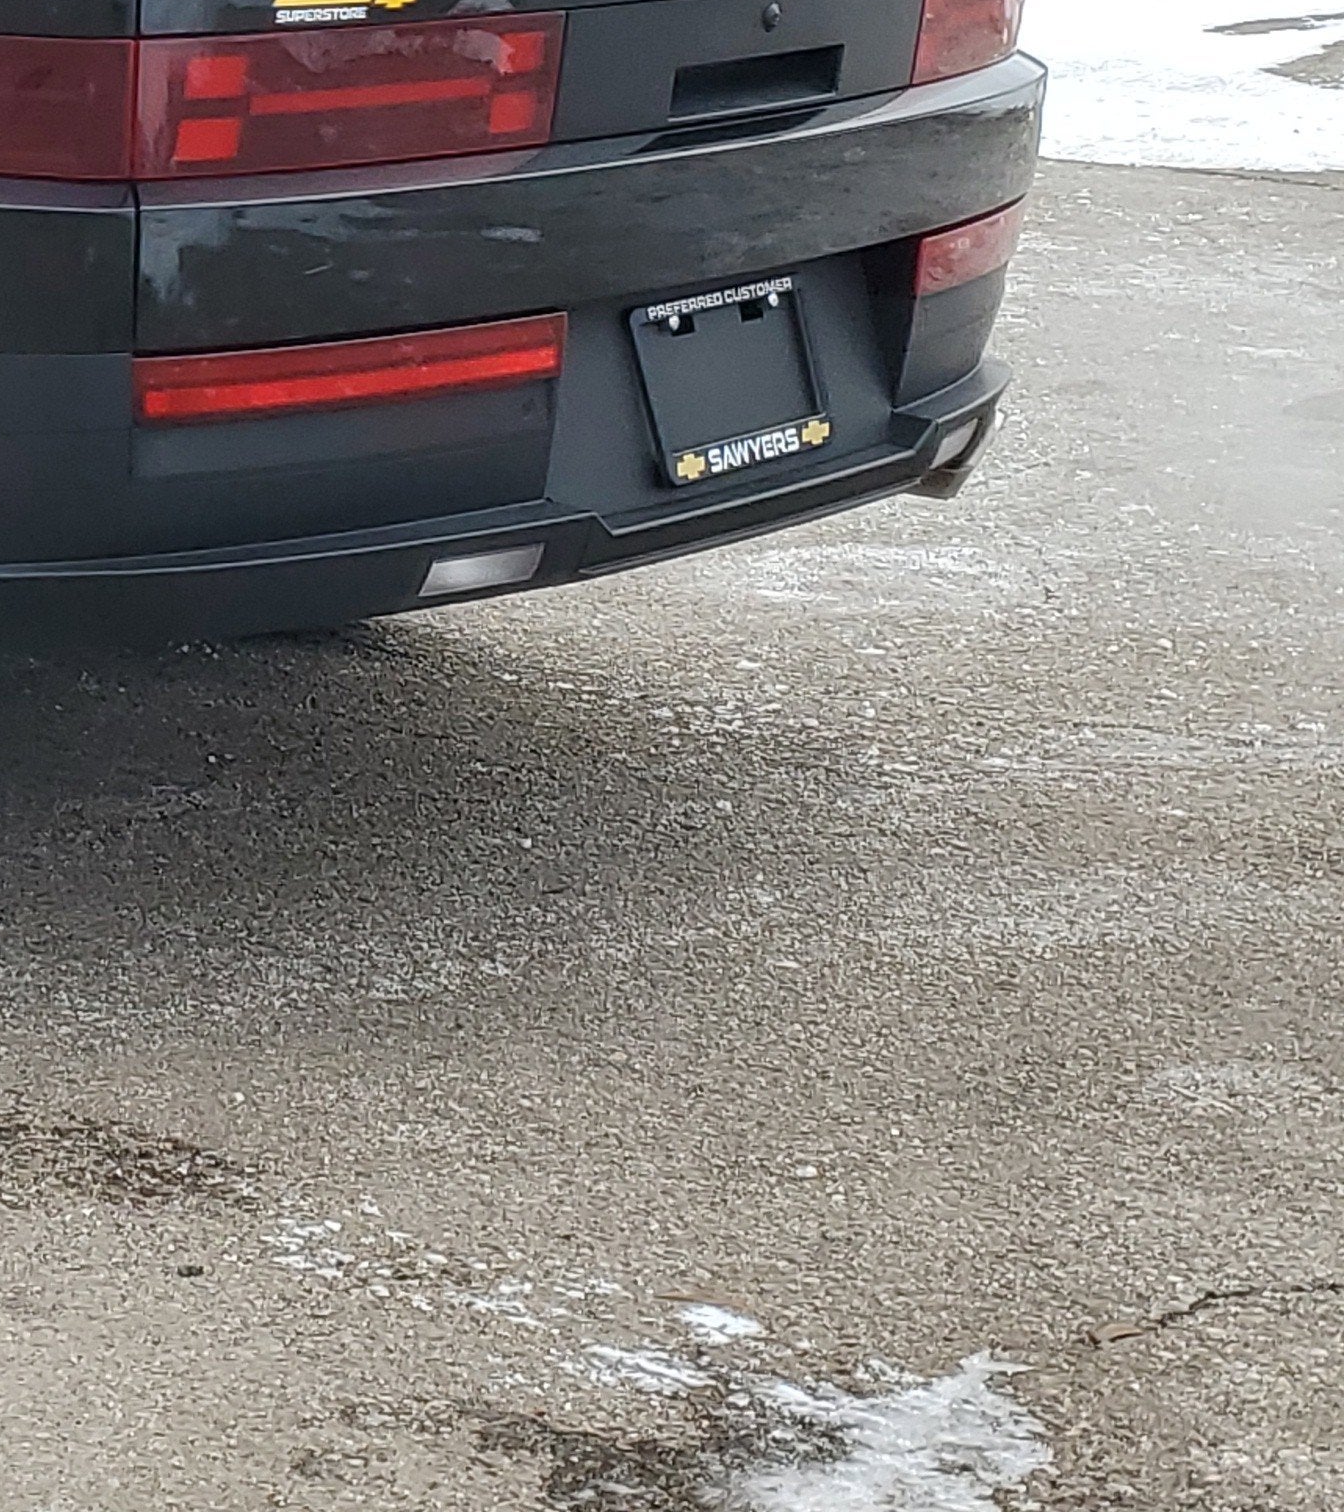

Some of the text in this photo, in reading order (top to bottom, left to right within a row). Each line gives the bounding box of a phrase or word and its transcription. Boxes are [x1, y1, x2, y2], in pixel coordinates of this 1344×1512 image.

[275, 6, 368, 24] SUPERSTORE
[647, 277, 792, 320] PREFERRED CUSTOMER
[708, 427, 800, 473] SAWYERS
